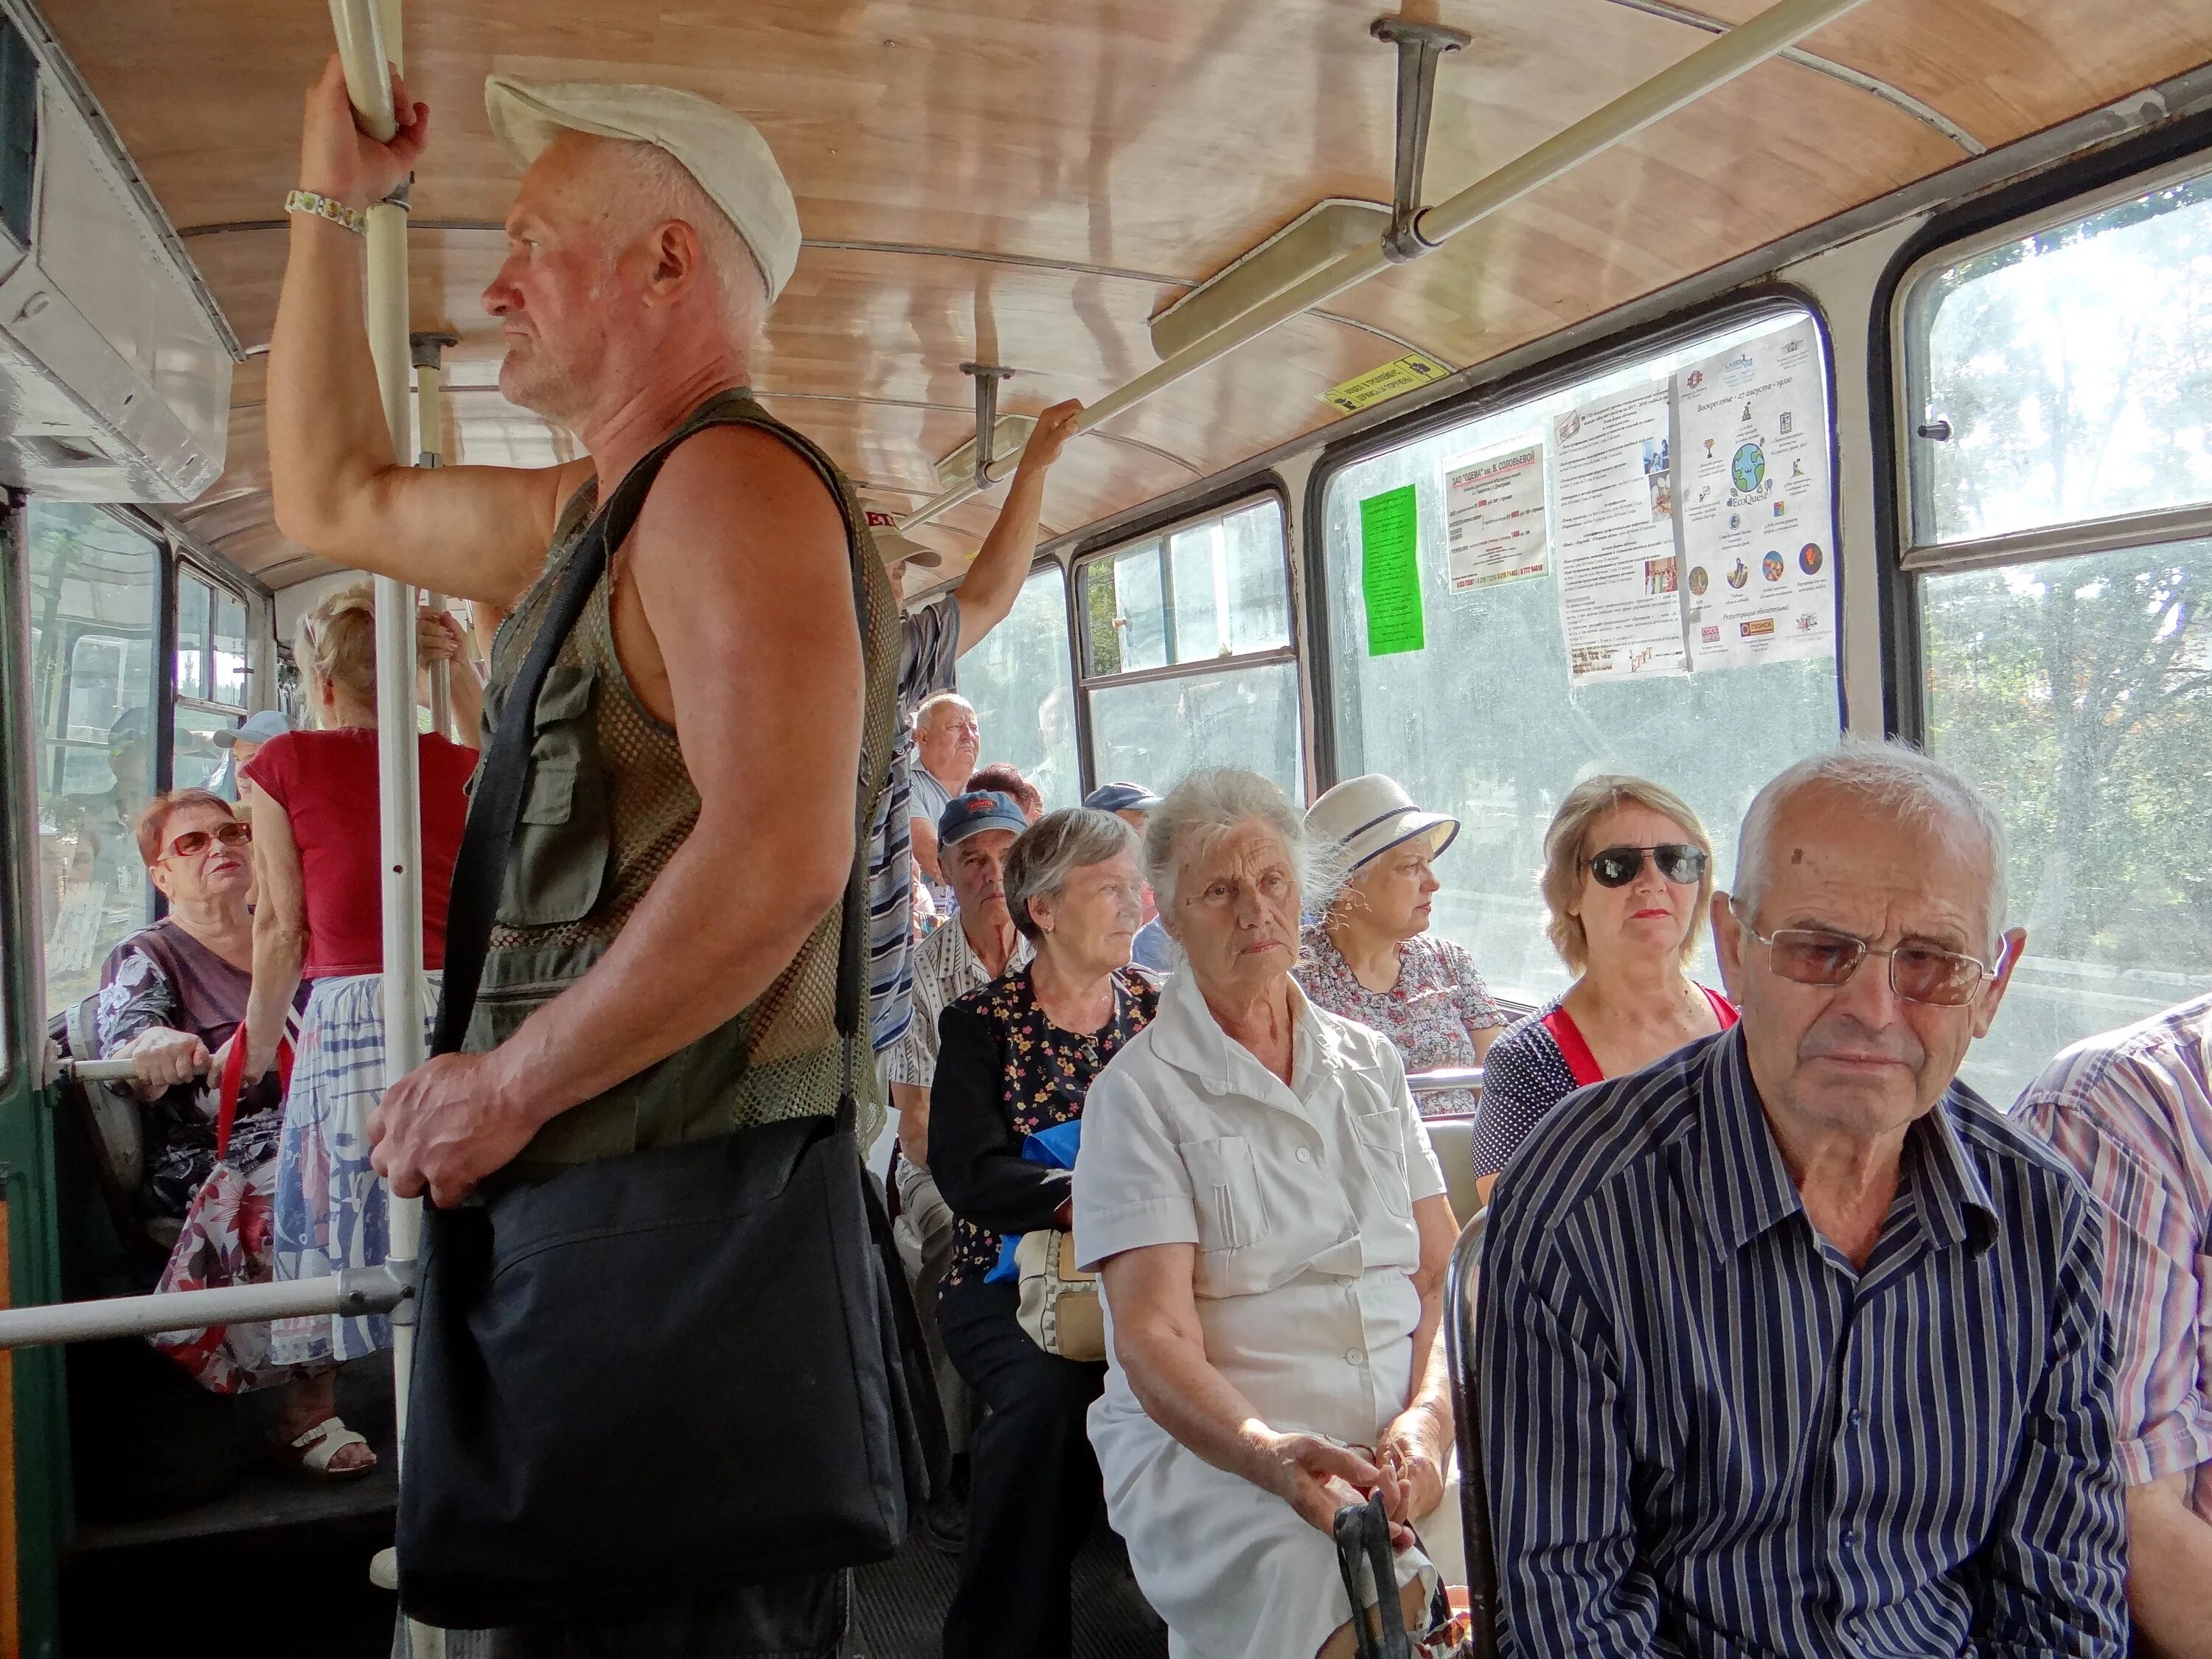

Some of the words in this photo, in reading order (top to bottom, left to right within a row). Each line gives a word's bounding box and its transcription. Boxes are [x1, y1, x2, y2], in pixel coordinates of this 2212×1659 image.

[1697, 396, 1732, 413] Воскресенье
[1746, 383, 1771, 397] августа
[1776, 377, 1792, 389] 19:00
[1452, 476, 1461, 485] ЗАО
[1462, 468, 1483, 481] "ОДЕМА"
[1492, 464, 1498, 472] В.
[1498, 450, 1534, 470] СОЛОВЬЕВОЙ
[1733, 493, 1767, 507] EcoQuest
[1723, 611, 1755, 621] Регистрация
[1756, 604, 1790, 614] обязательна!
[1750, 622, 1772, 630] ПОИСК
